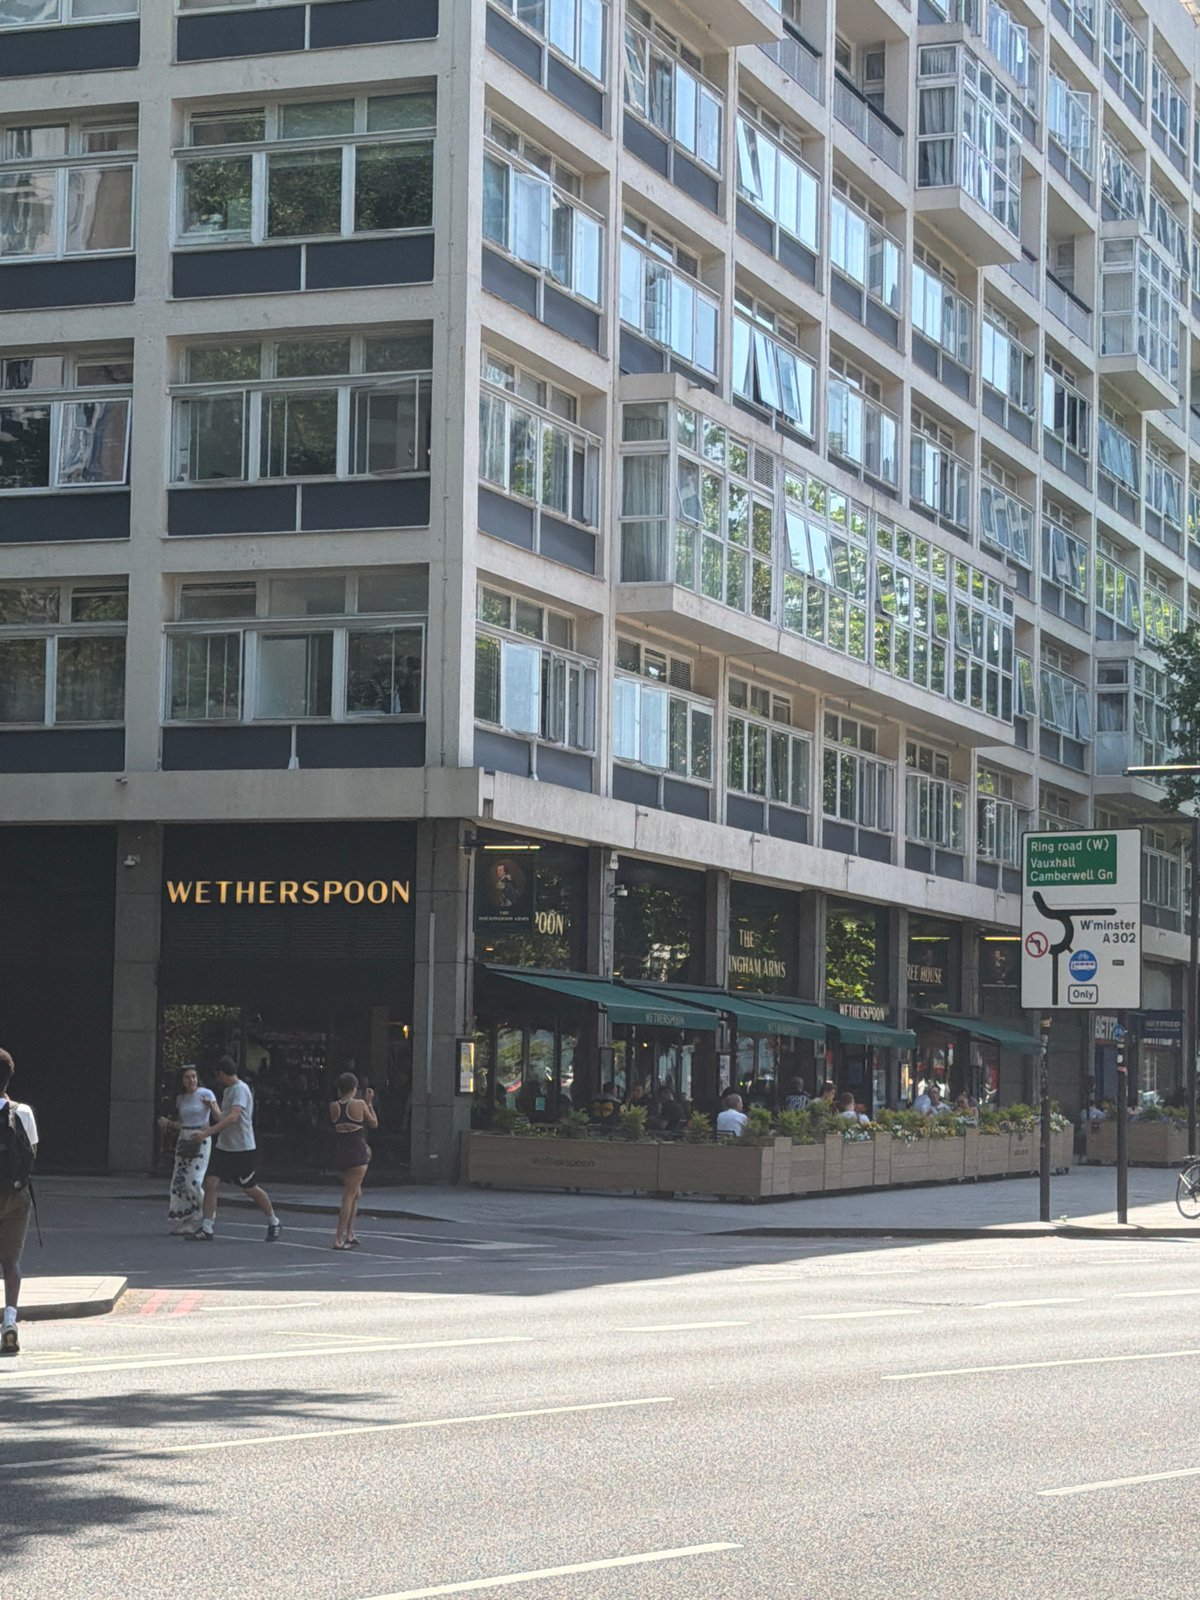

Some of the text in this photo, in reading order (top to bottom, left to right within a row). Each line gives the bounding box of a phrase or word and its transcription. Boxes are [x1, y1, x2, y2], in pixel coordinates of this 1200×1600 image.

[1031, 838, 1109, 853] Ring road (W)
[1030, 857, 1076, 868] Vauxhall
[1030, 869, 1113, 881] Camberwell Gn
[166, 880, 410, 904] WETHERSPOON
[1080, 920, 1136, 931] W'minster
[739, 929, 755, 947] THE
[762, 957, 786, 978] ARMS
[1072, 988, 1094, 999] Only
